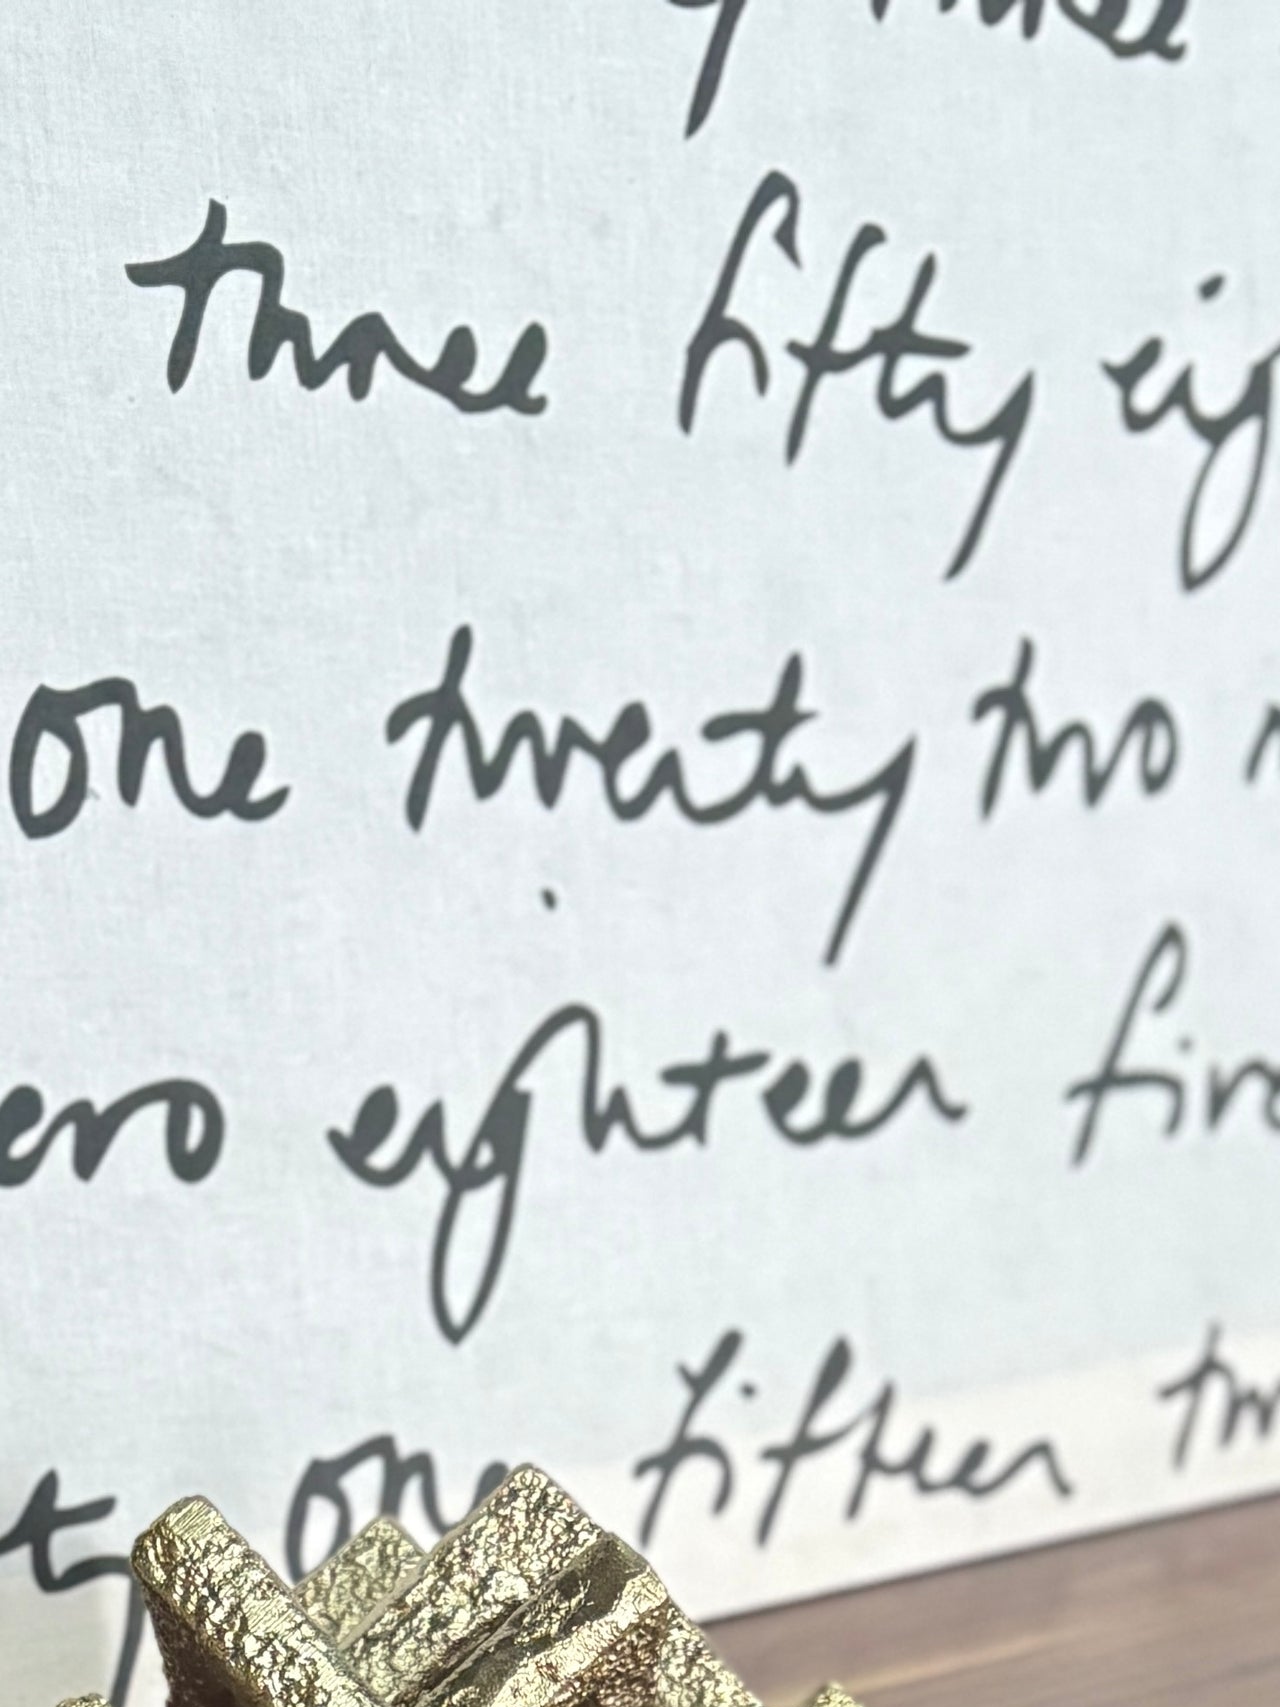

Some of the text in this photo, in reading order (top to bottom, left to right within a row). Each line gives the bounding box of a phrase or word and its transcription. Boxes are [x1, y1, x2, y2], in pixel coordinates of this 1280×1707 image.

[124, 198, 548, 417] three
[677, 169, 1035, 582] fifty
[8, 676, 291, 840] one
[384, 622, 919, 969] twenty
[970, 633, 1180, 824] two
[325, 888, 969, 1348] eighteen
[632, 1326, 1074, 1551] fifteen
